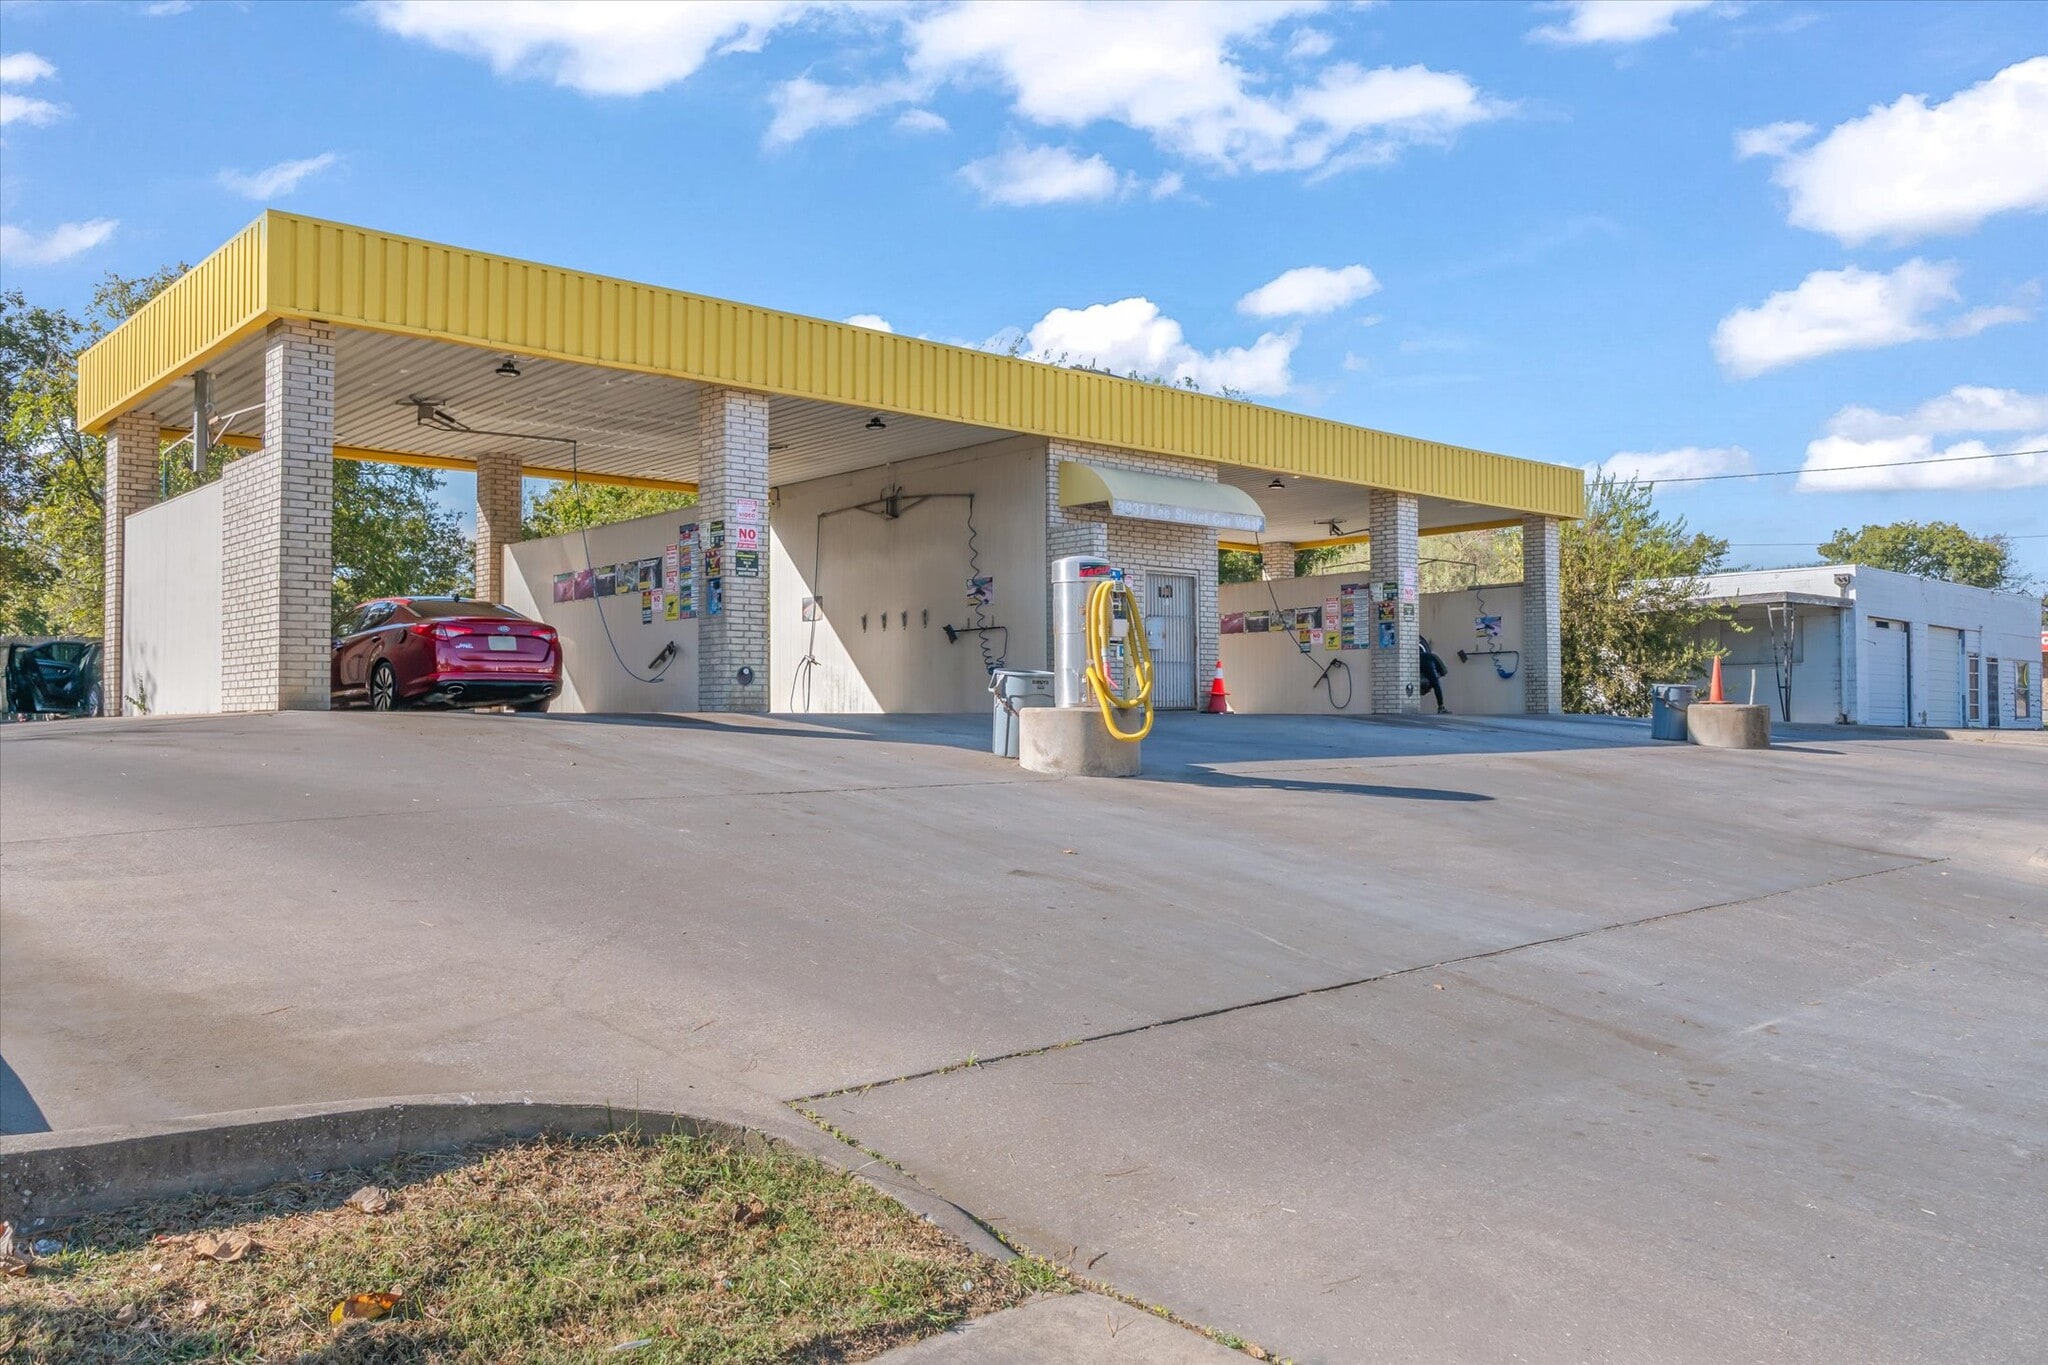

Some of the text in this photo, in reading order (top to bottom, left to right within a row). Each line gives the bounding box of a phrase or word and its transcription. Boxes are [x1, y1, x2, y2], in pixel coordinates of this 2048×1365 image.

[1150, 504, 1170, 519] Lee
[1175, 508, 1209, 523] Street
[1212, 513, 1232, 526] Car
[739, 528, 756, 540] NO
